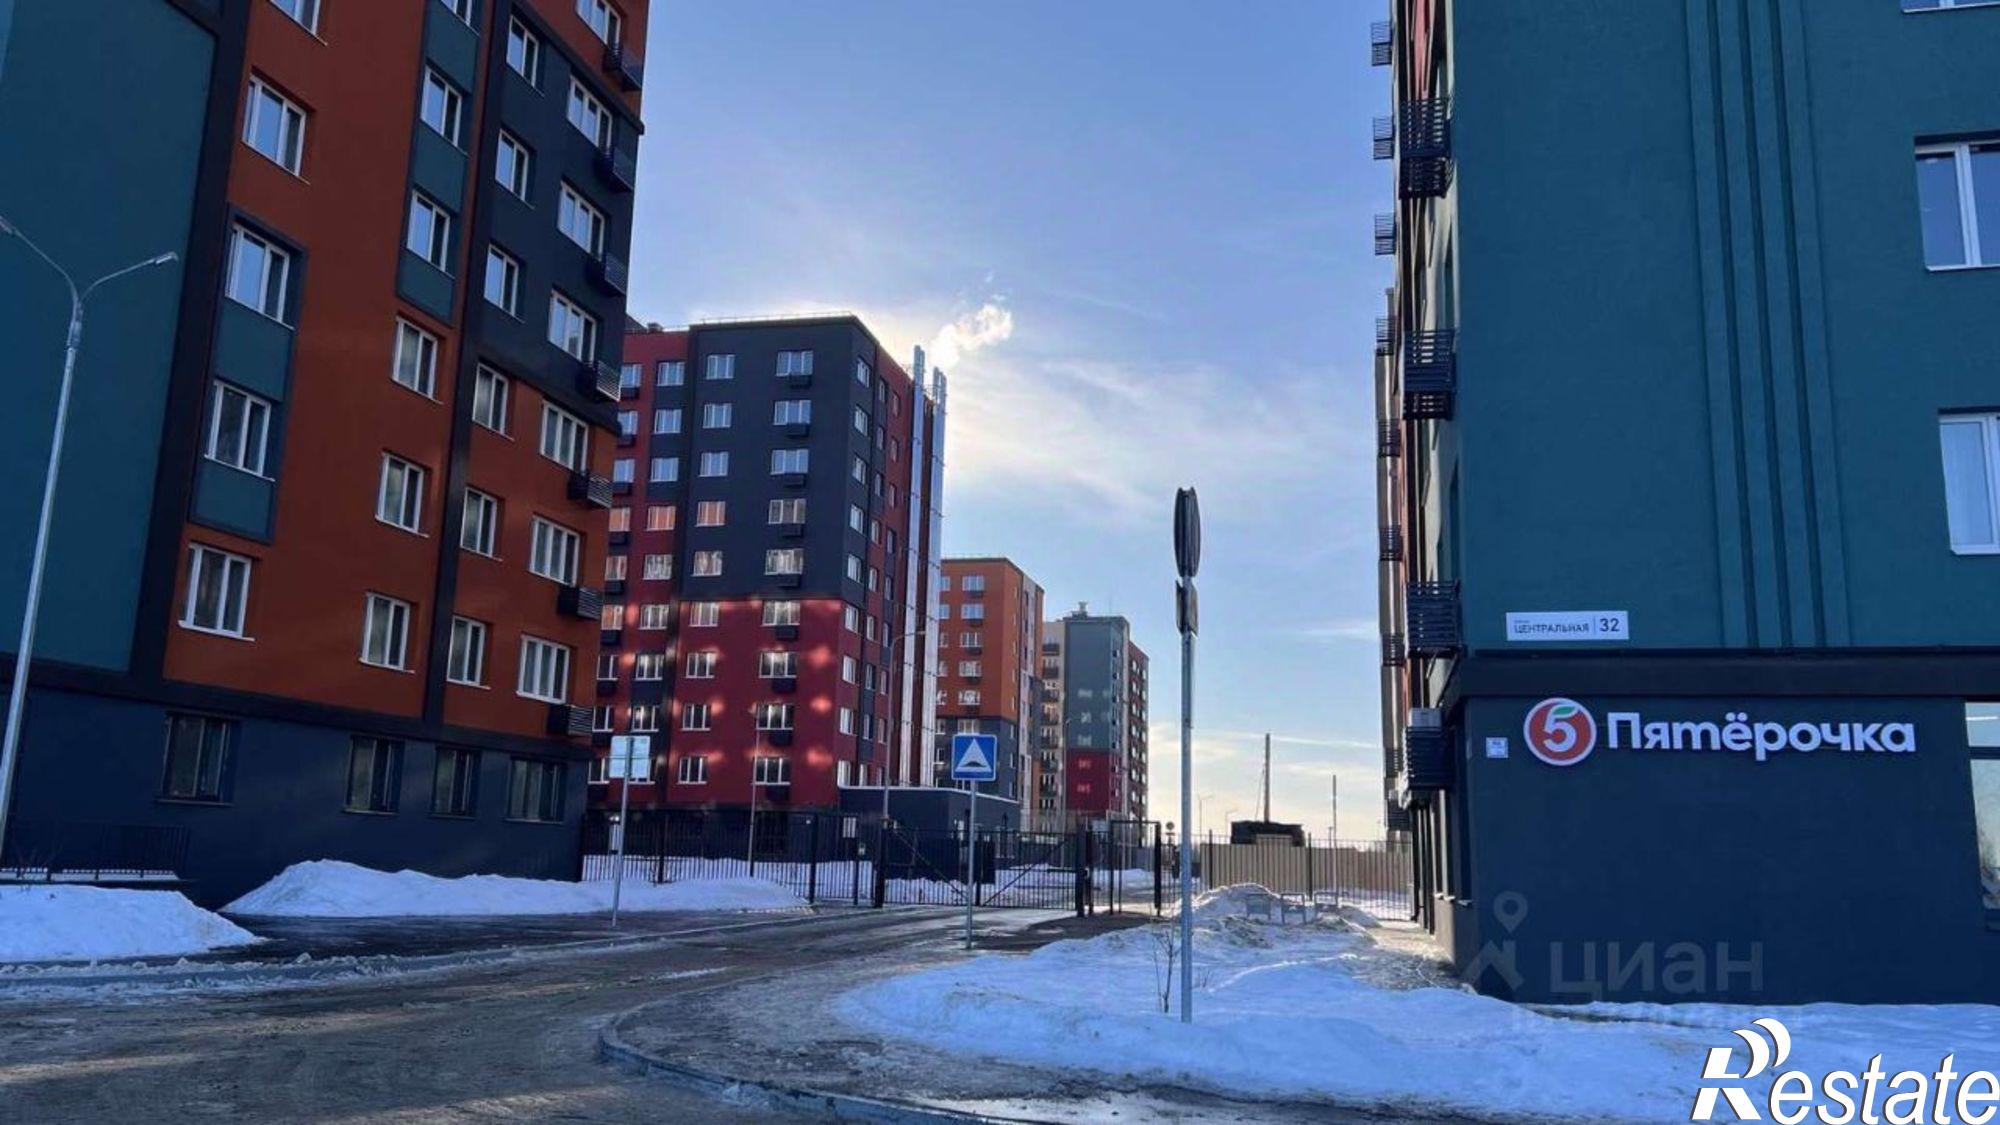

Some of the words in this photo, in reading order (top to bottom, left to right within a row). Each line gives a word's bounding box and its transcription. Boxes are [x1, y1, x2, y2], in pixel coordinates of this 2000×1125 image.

[1514, 623, 1590, 634] ЦЕНТРАЛЬНАЯ
[1599, 617, 1620, 632] 32
[1543, 706, 1577, 752] 5
[1606, 712, 1917, 761] Пятёрочка
